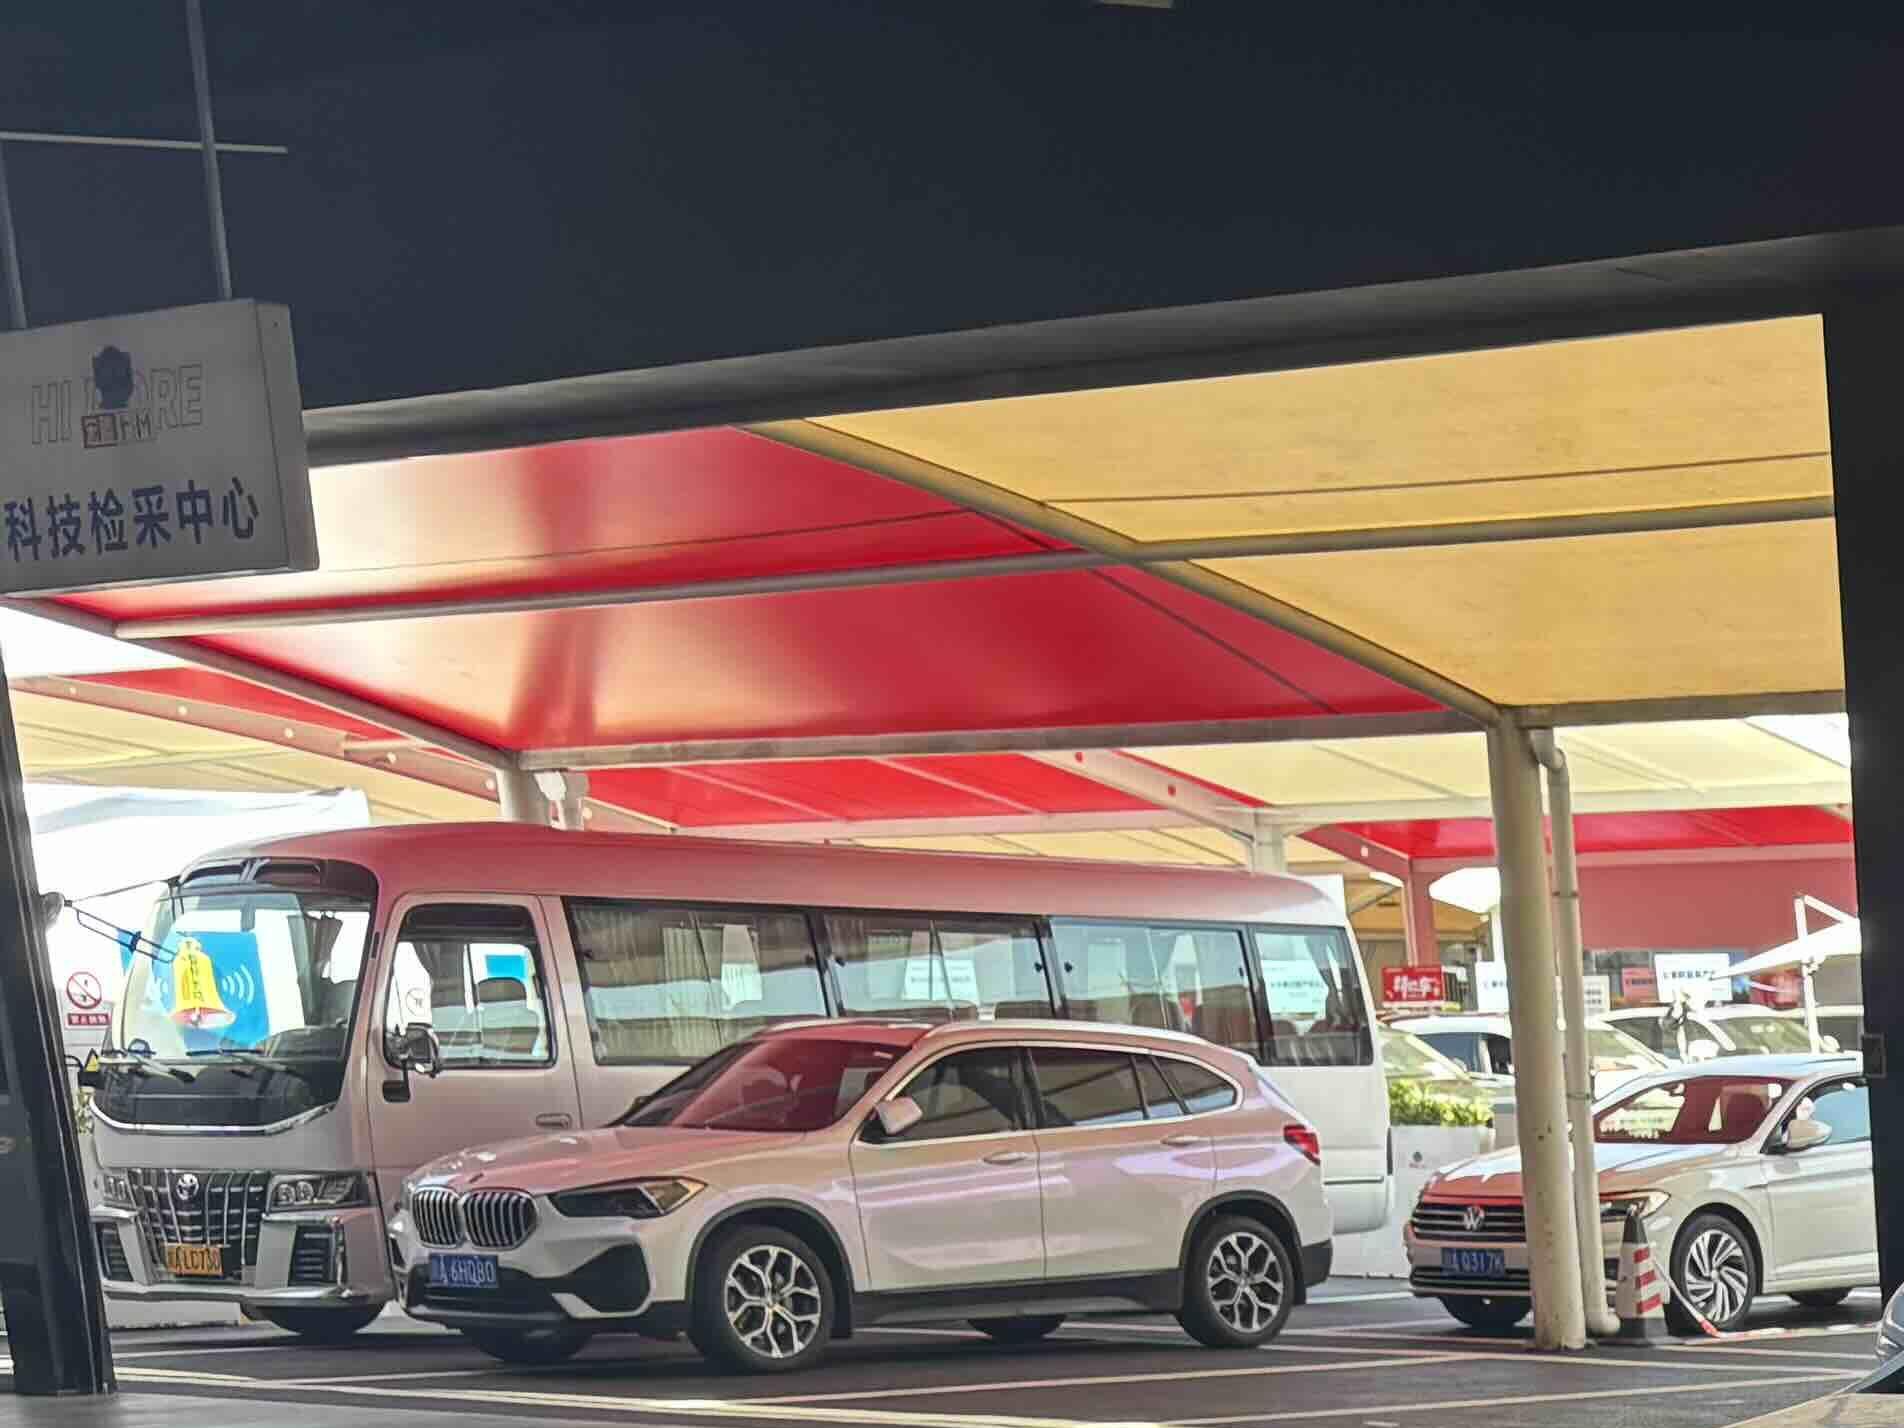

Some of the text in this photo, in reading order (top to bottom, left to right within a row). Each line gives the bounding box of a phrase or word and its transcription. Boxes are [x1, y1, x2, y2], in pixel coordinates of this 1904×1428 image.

[4, 476, 259, 562] 科技检采中心
